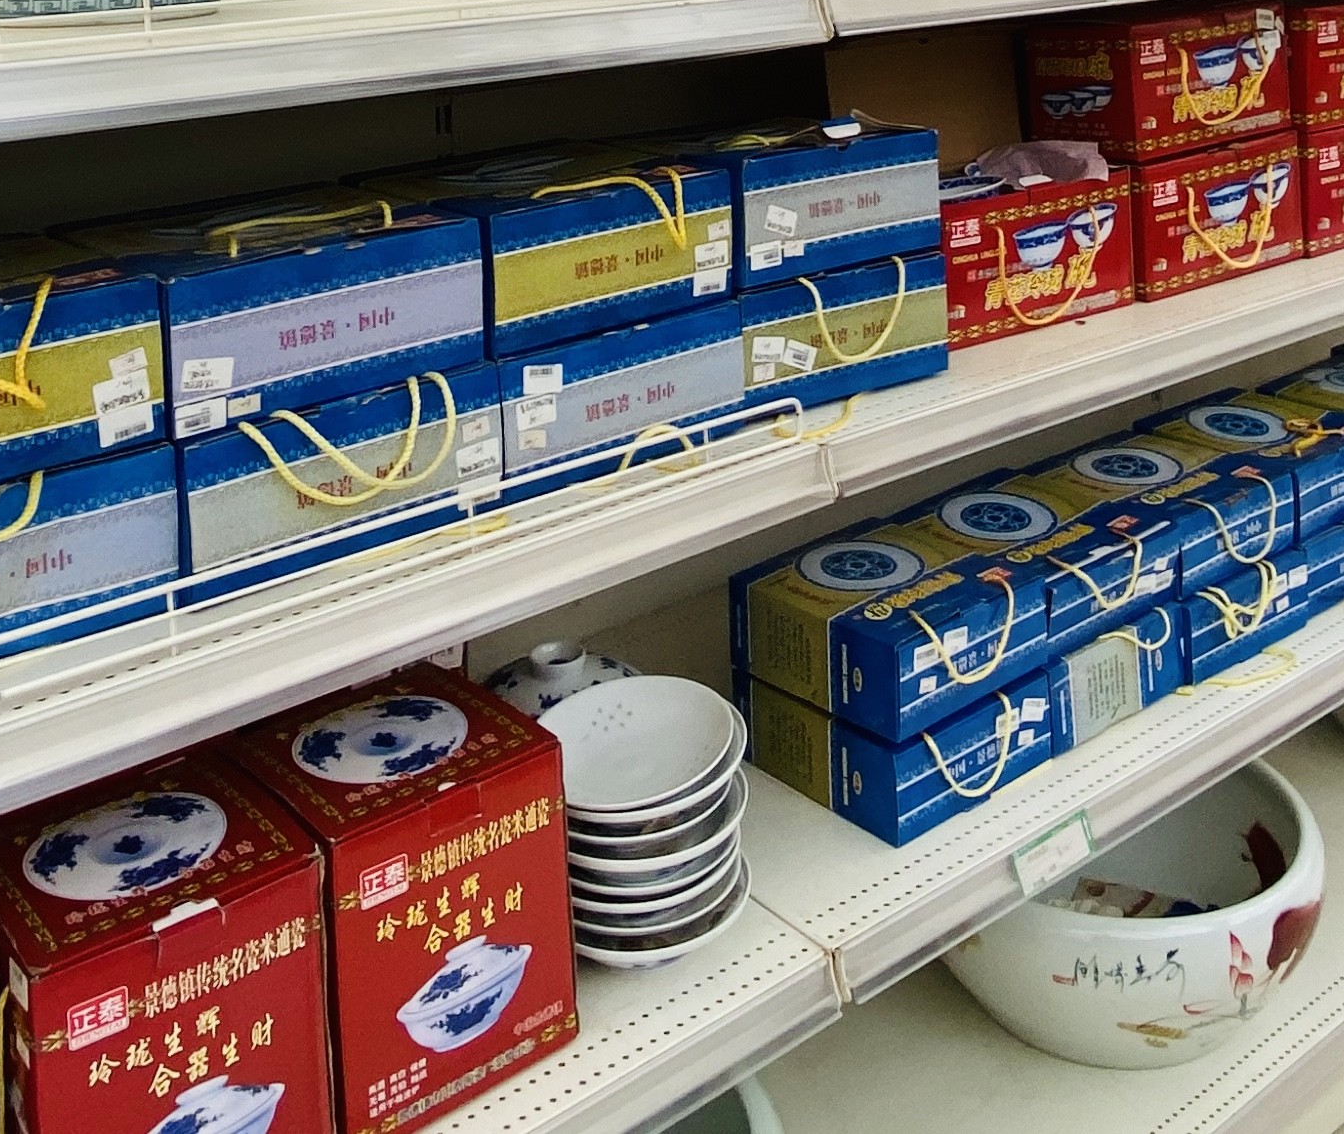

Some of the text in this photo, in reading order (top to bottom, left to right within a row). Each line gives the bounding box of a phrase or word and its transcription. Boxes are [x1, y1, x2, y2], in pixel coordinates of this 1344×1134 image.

[1140, 38, 1165, 56] 正泰
[1153, 179, 1178, 199] 正泰
[951, 218, 980, 239] 正泰
[420, 797, 550, 883] 景德镇传统名瓷米通瓷
[363, 860, 405, 897] 正泰
[376, 872, 480, 942] 玲珑生辉
[424, 882, 524, 955] 合器生财
[143, 916, 306, 1018] 景德镇传统名瓷米通瓷
[71, 993, 124, 1037] 正泰
[88, 1005, 221, 1088] 玲珑生辉
[148, 1012, 274, 1098] 合器生财
